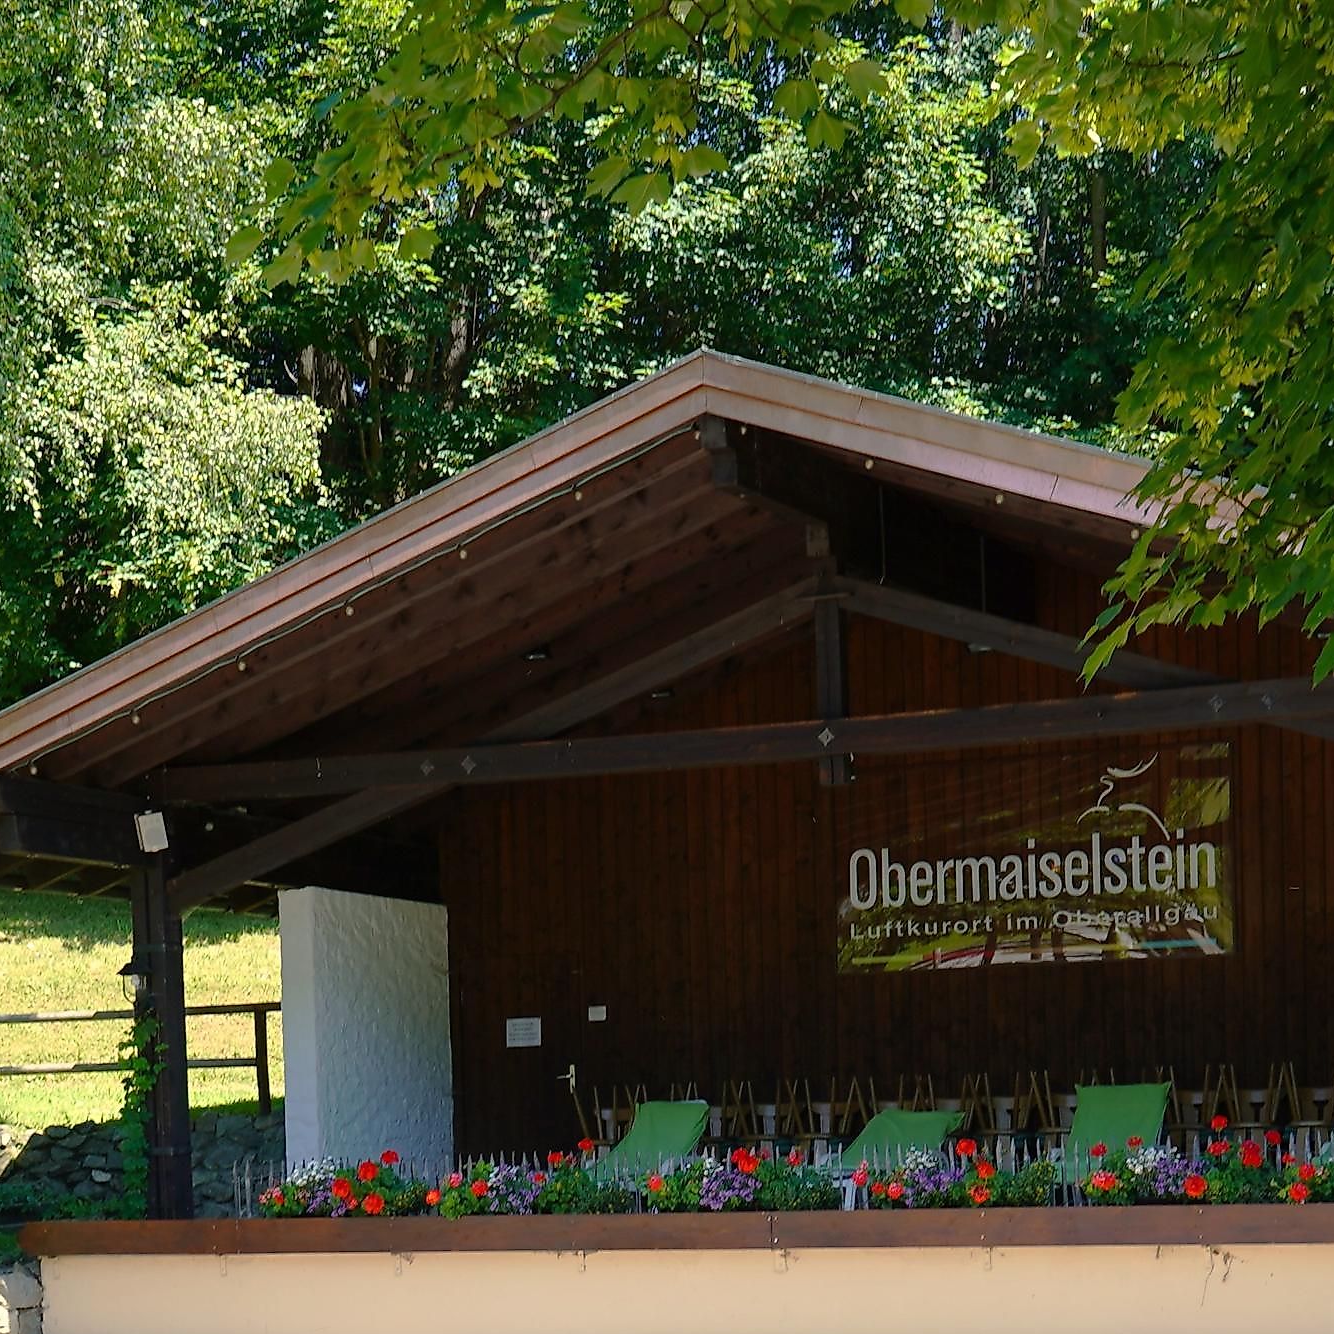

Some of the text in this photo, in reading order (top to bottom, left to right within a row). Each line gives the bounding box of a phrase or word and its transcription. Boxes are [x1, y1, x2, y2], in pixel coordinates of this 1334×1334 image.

[848, 829, 1216, 911] Obermaiselstein
[850, 914, 994, 940] Luftkurort
[1006, 912, 1039, 931] im
